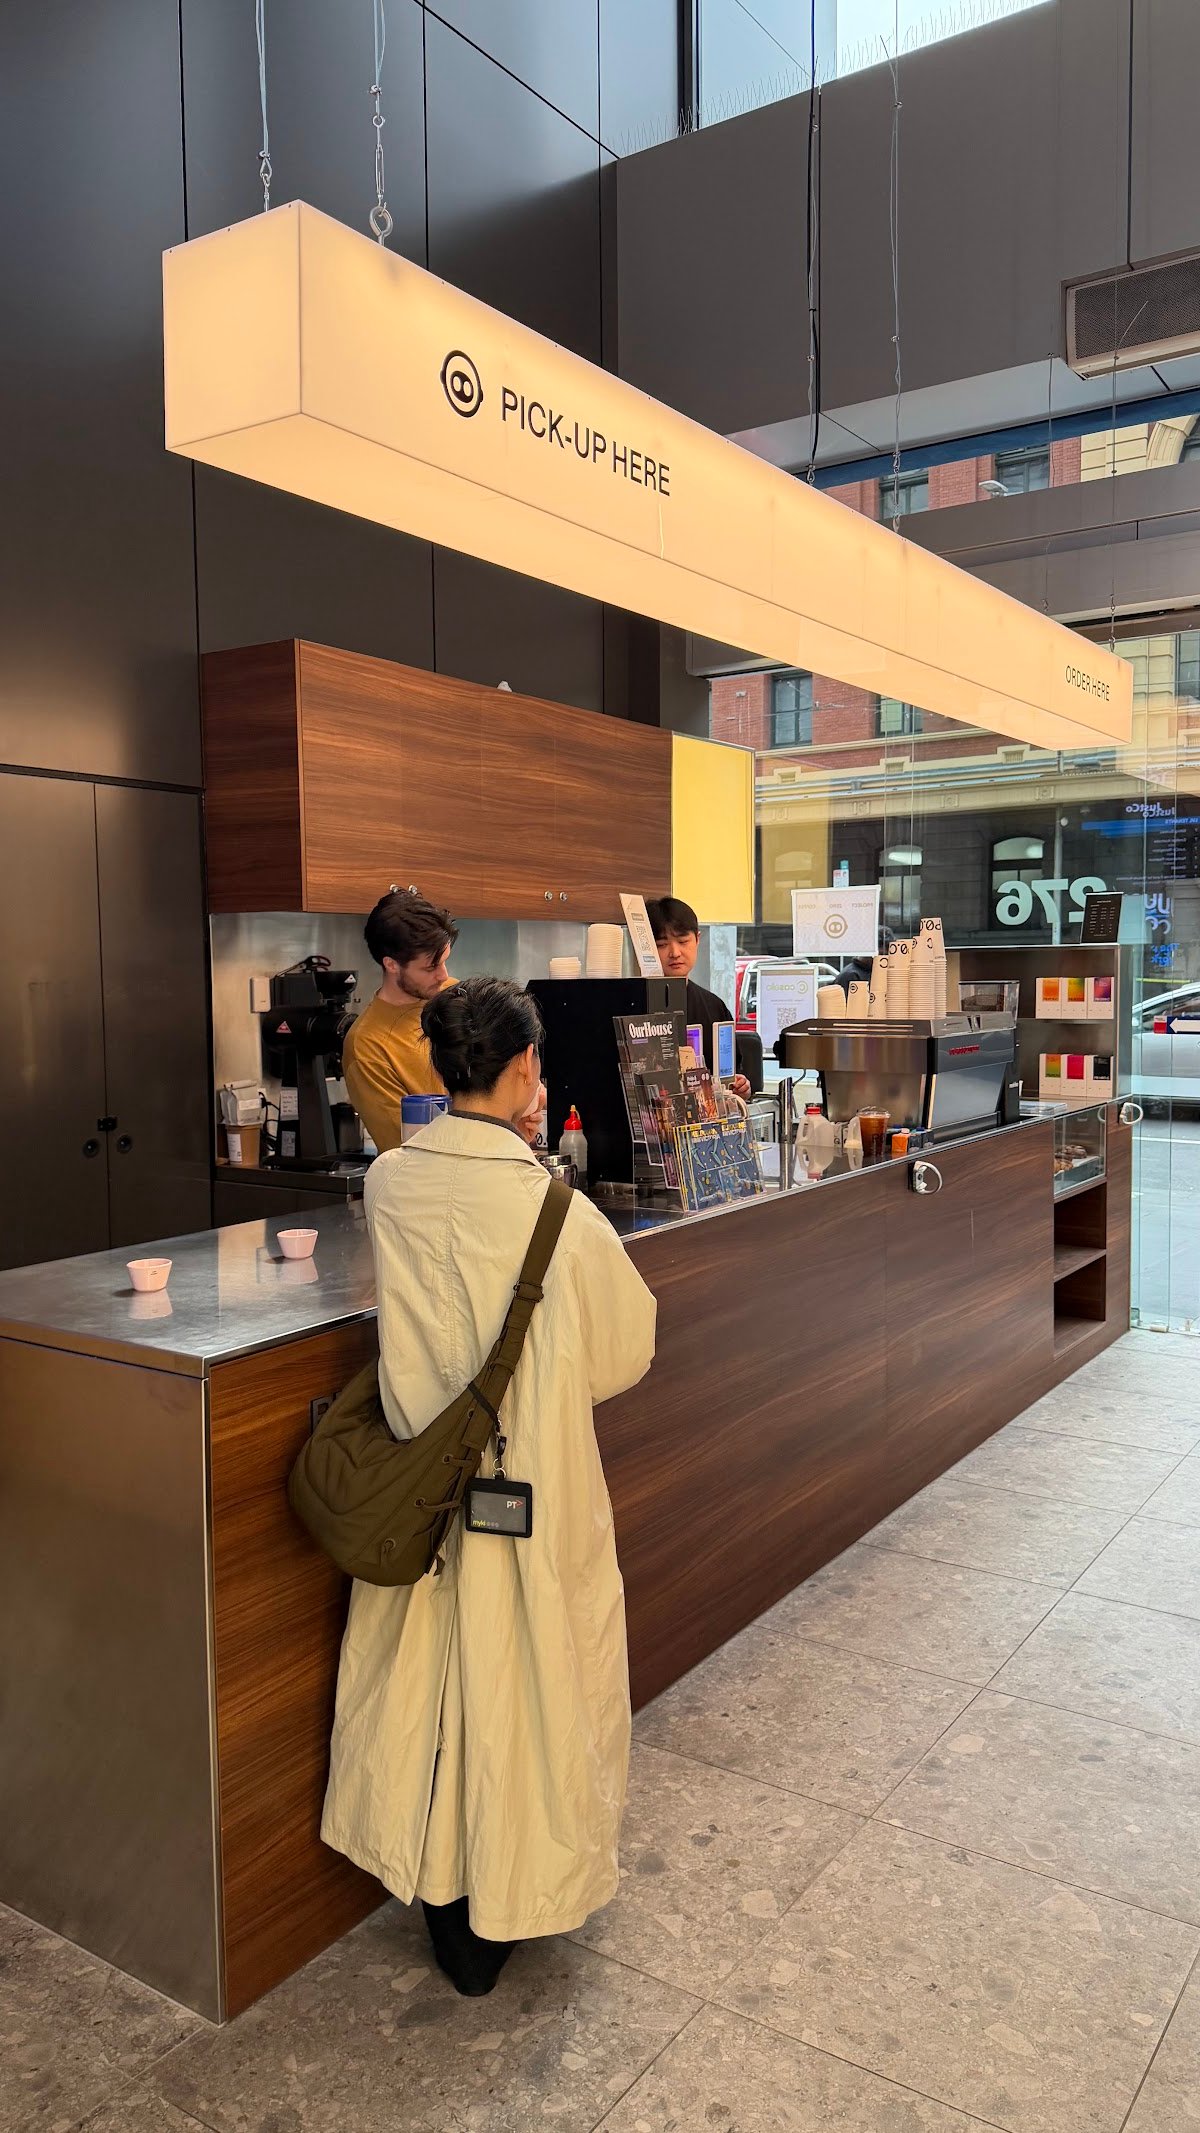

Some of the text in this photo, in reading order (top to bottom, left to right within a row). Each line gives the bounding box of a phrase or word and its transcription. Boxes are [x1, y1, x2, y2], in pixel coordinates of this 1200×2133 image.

[501, 386, 671, 496] PICK-UP HERE
[1065, 665, 1110, 701] ORDER HERE
